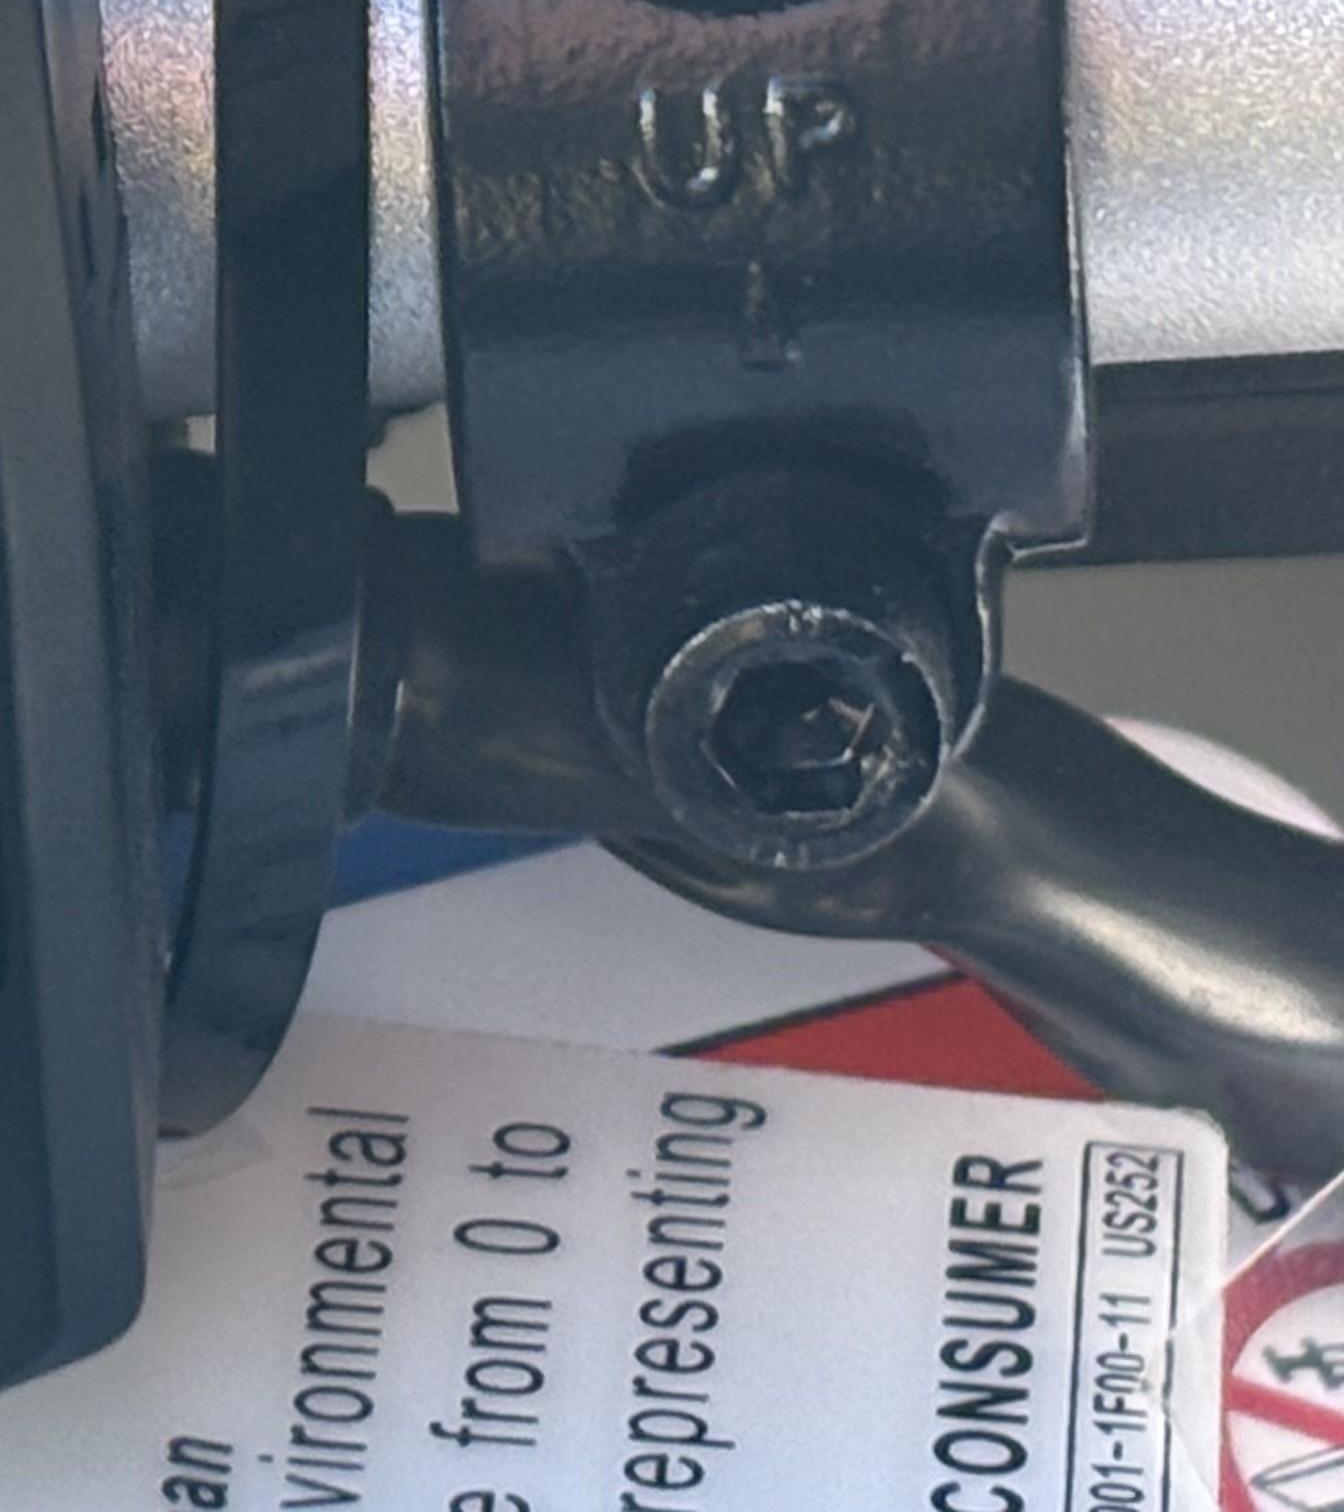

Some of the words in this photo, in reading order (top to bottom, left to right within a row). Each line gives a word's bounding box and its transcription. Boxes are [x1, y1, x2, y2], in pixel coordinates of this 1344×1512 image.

[630, 76, 850, 206] UP
[468, 1122, 571, 1180] to
[1102, 1152, 1160, 1258] US252
[453, 1219, 560, 1255] 0
[620, 1092, 767, 1512] representing
[430, 1296, 552, 1447] from
[930, 1154, 1043, 1512] CONSUMER
